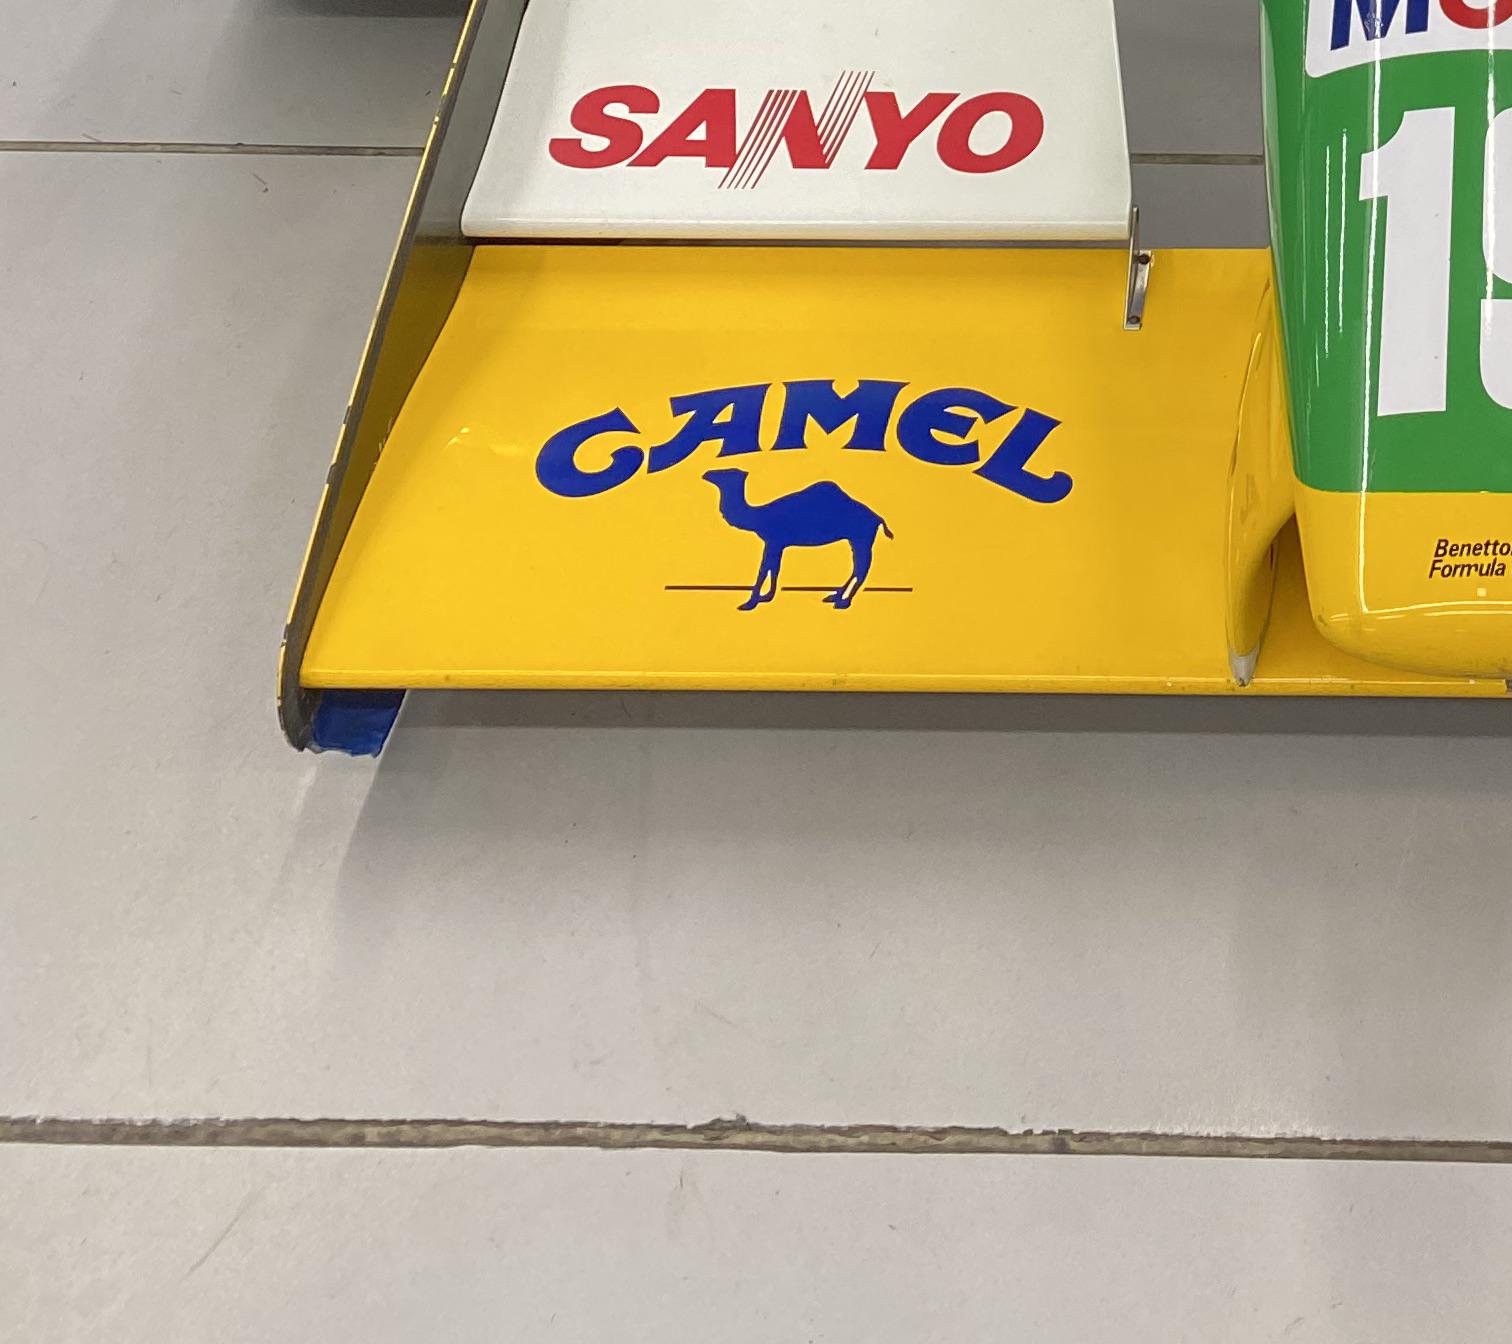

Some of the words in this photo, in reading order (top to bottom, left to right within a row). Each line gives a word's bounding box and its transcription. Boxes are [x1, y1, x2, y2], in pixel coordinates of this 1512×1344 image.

[548, 69, 1045, 191] SANYO
[535, 378, 1074, 504] CAMEL
[1428, 557, 1506, 579] Formula
